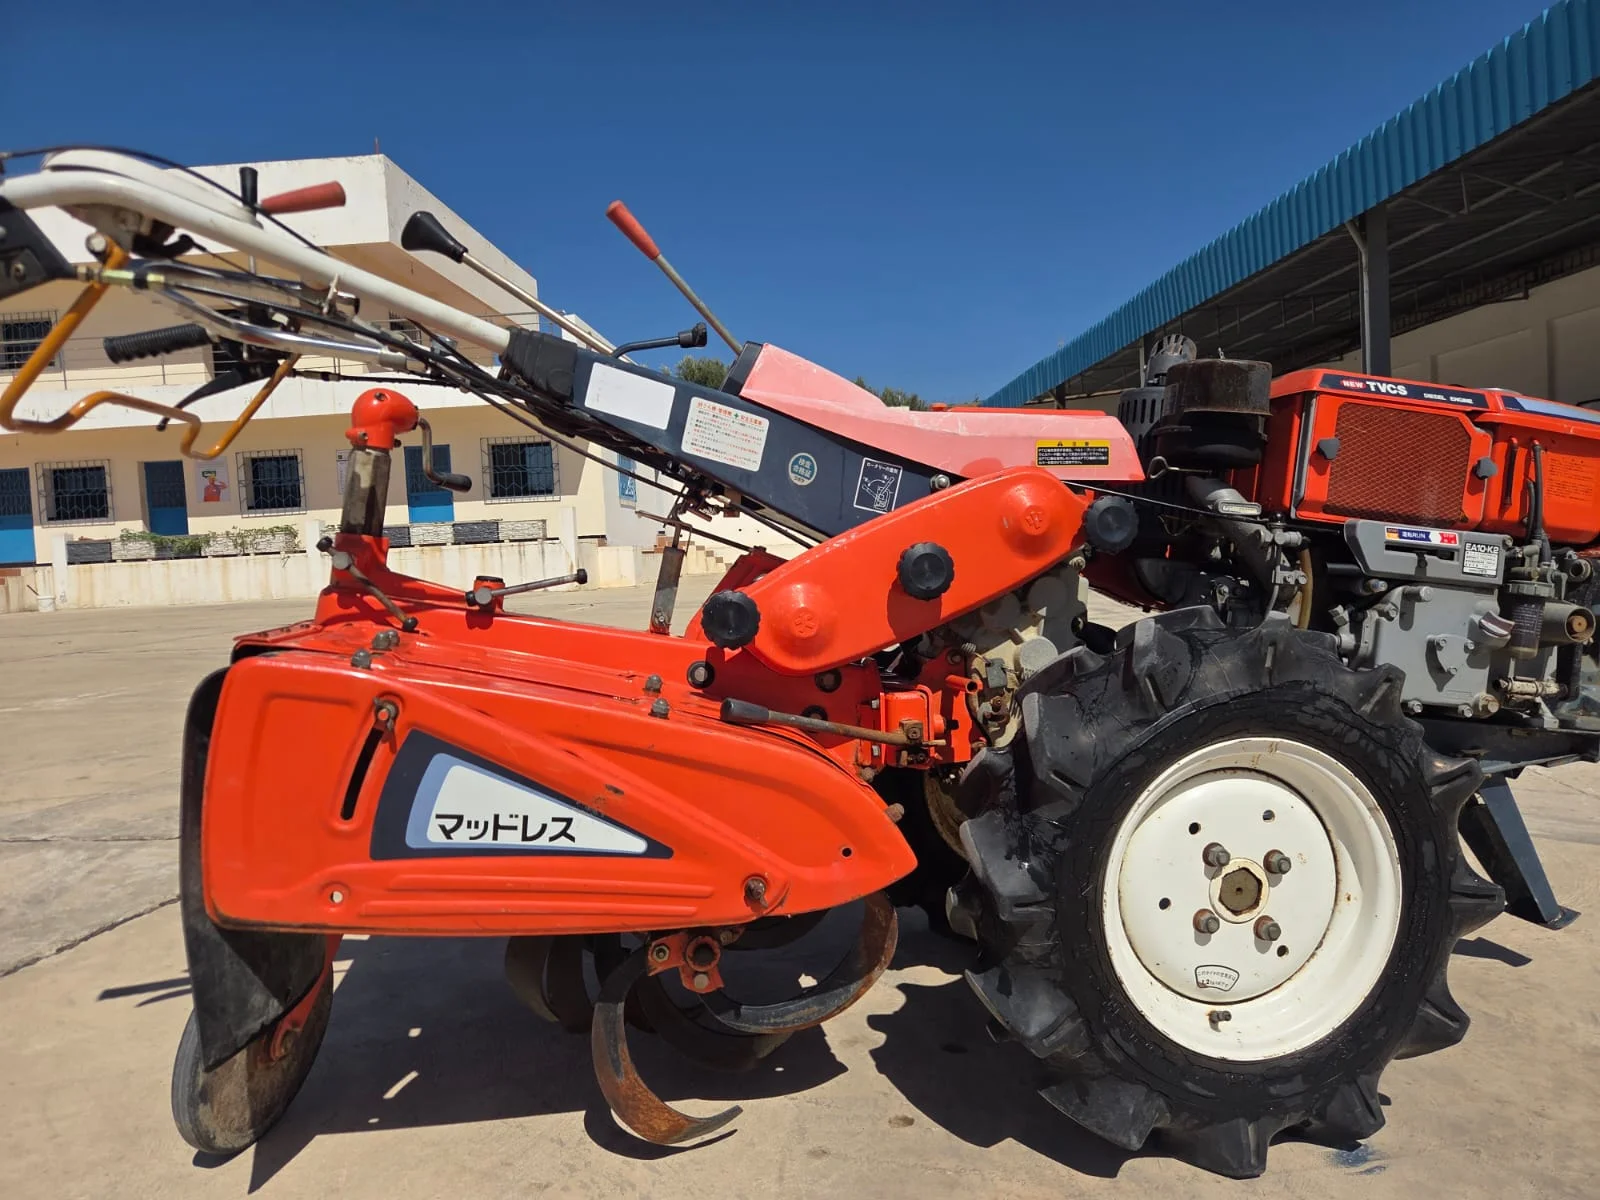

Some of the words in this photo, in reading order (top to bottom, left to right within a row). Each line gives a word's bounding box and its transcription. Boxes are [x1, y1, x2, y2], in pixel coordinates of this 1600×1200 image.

[1342, 380, 1364, 389] NEW
[1366, 381, 1408, 396] TVCS
[435, 813, 576, 844] マッドレス
